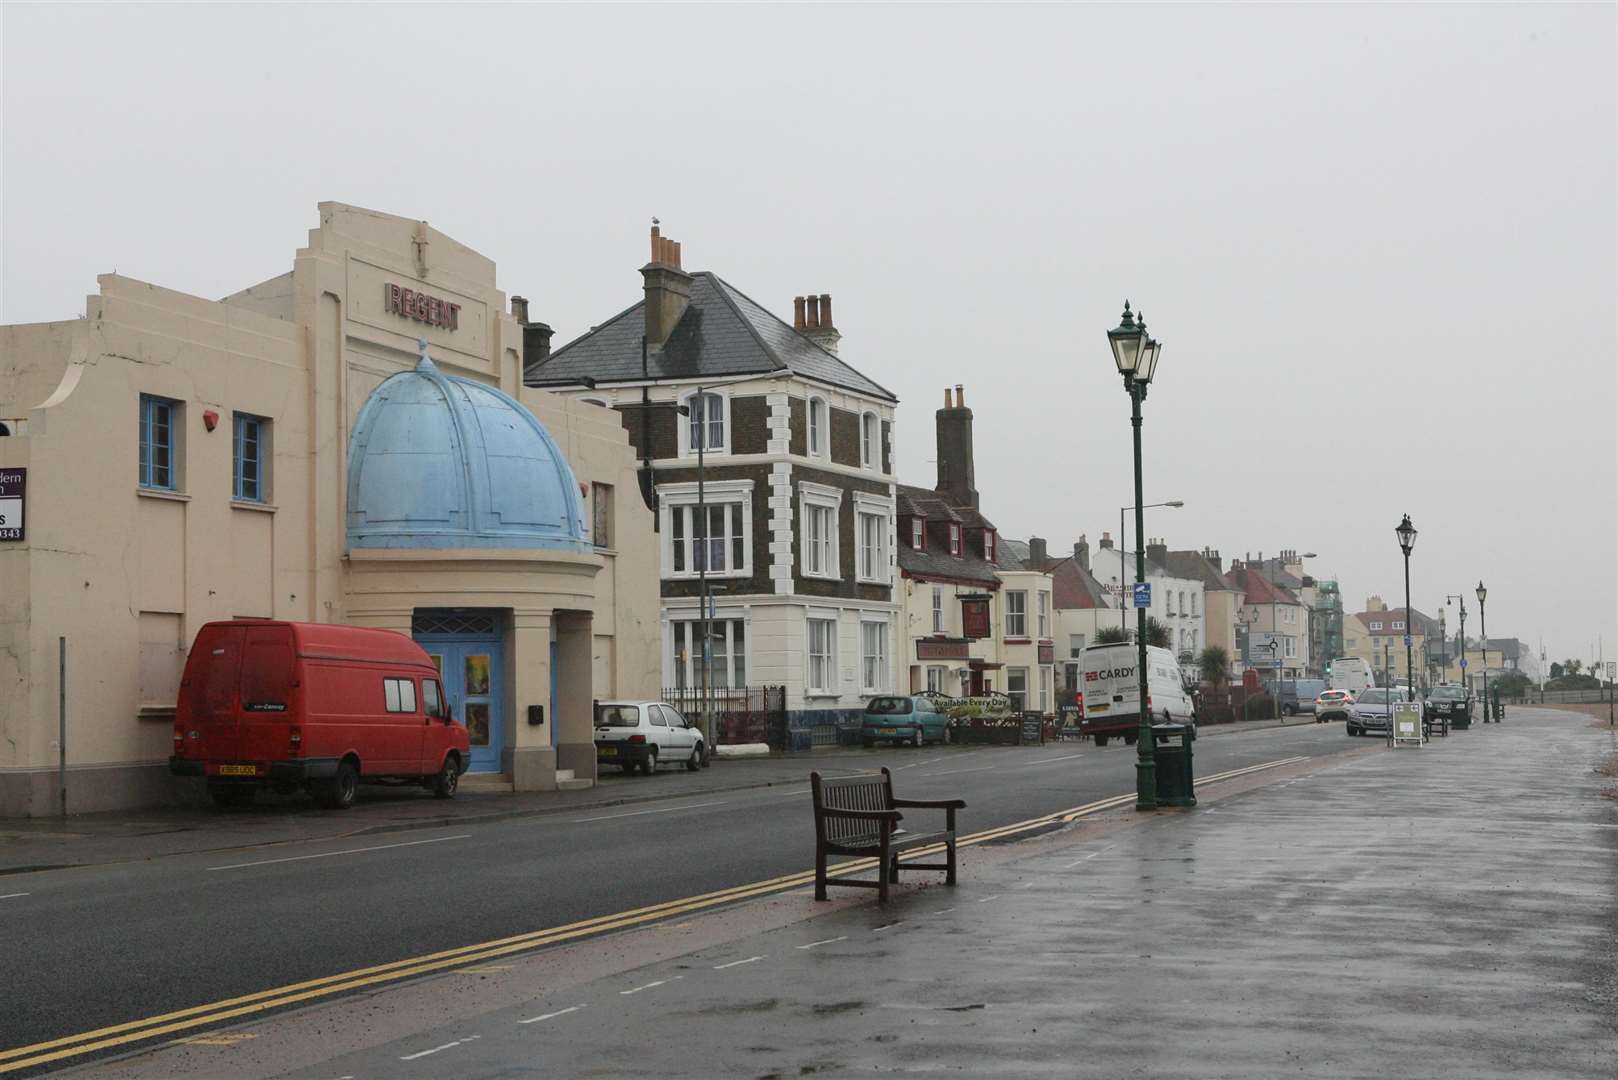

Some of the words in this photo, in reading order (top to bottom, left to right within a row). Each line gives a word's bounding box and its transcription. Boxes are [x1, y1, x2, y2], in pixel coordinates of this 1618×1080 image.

[384, 283, 461, 332] REGENT
[0, 529, 20, 538] 343
[1099, 667, 1135, 680] CARDY
[934, 699, 968, 707] Available
[969, 699, 990, 708] Every
[991, 698, 1008, 707] Day
